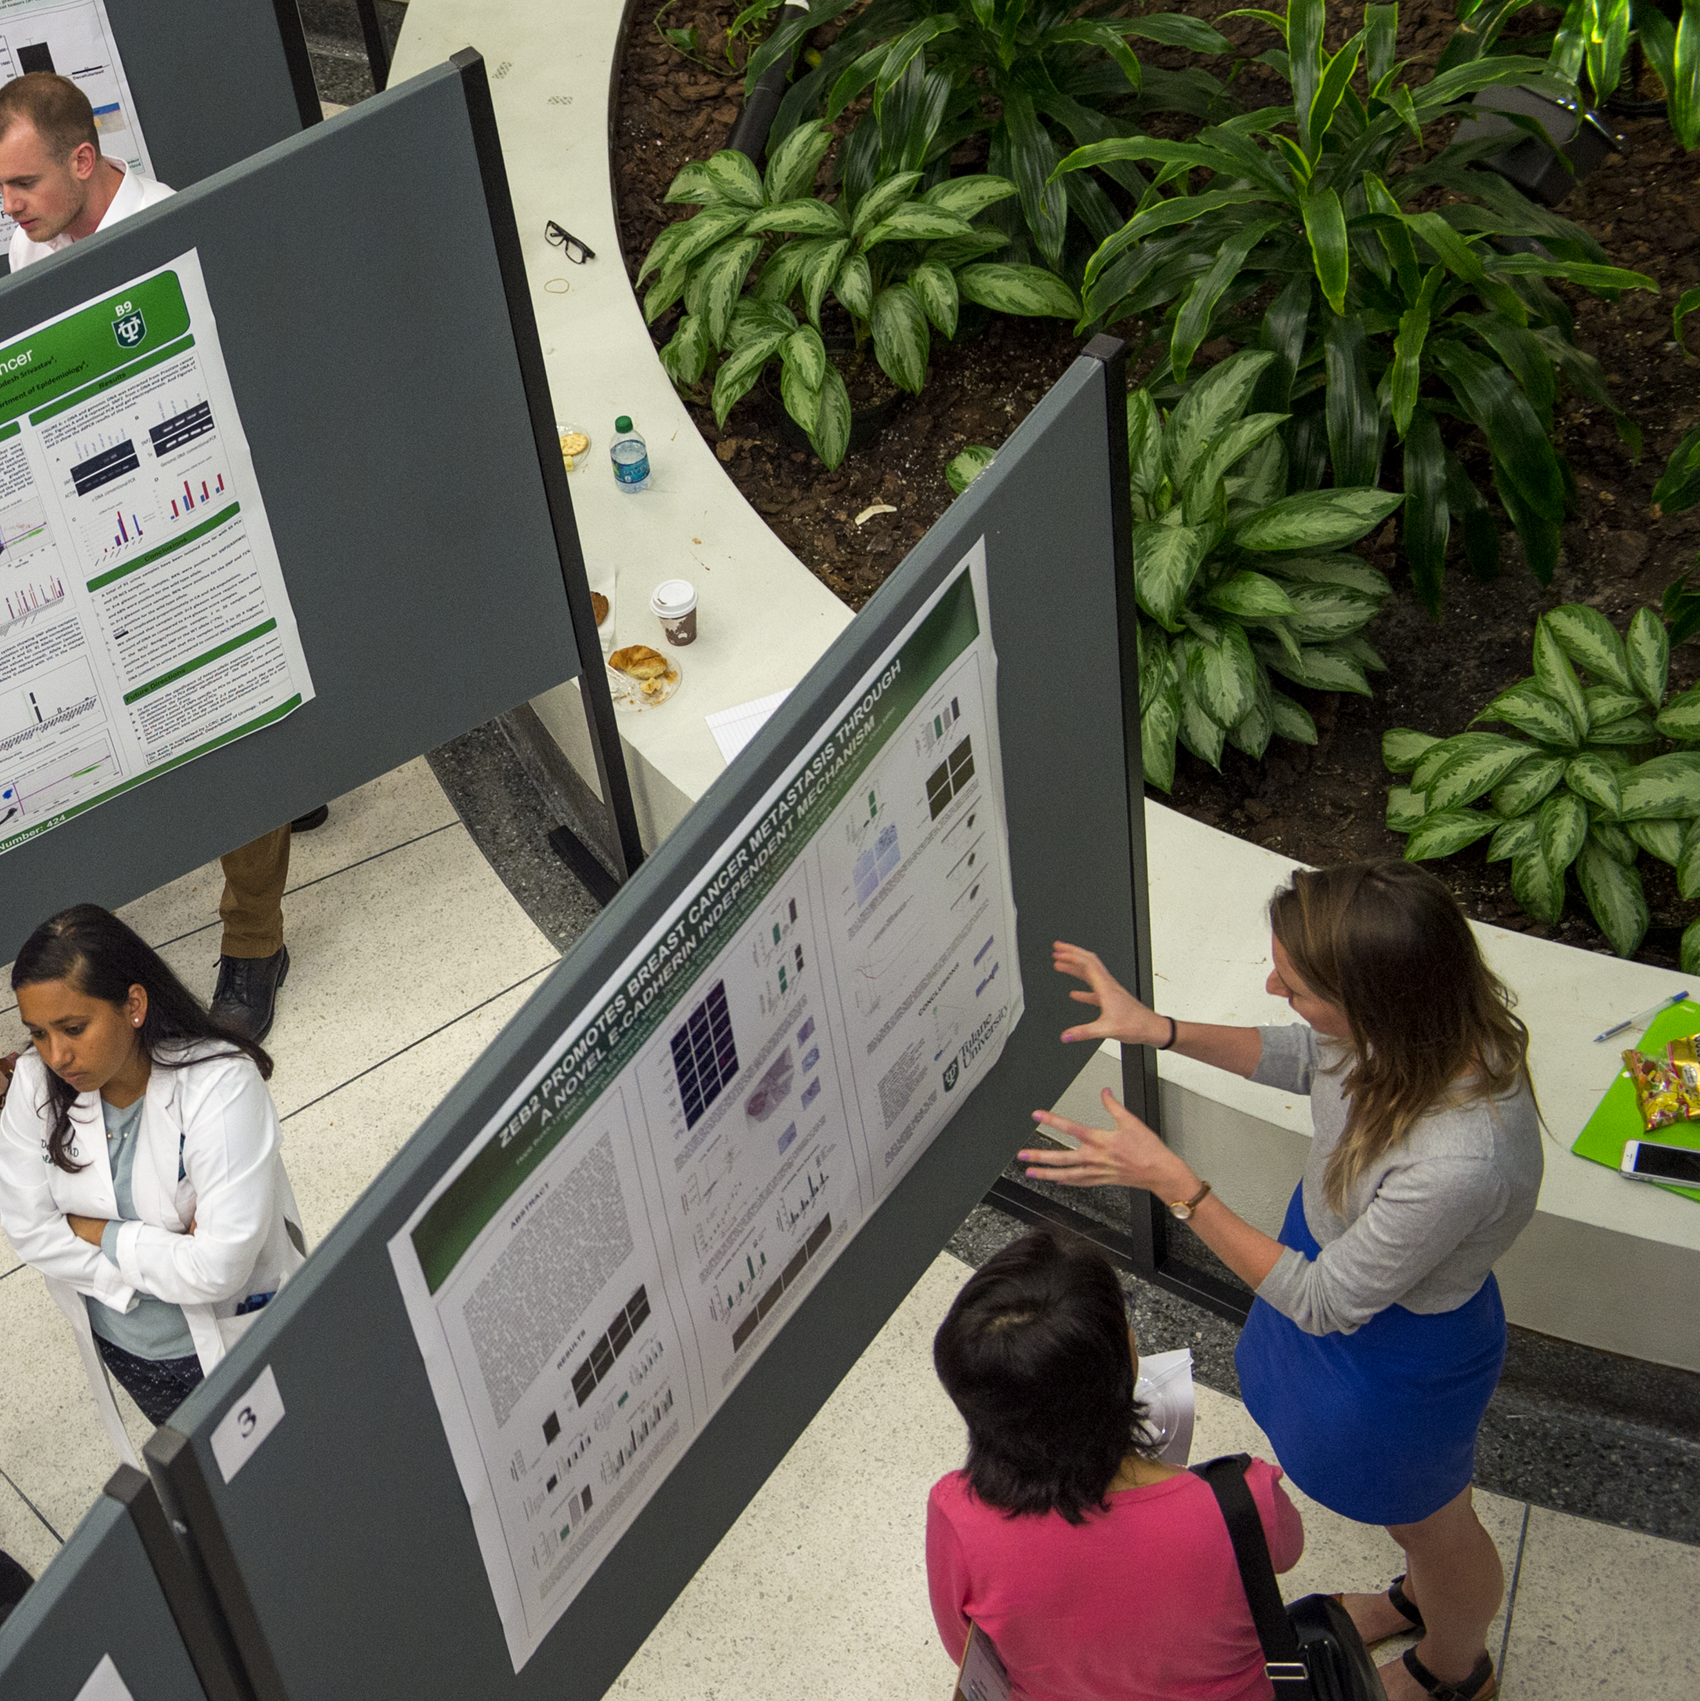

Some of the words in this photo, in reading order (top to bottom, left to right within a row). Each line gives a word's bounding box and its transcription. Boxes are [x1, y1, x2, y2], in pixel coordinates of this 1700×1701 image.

[114, 300, 133, 317] B9
[98, 372, 127, 390] Results
[143, 536, 188, 563] Conclusions
[125, 687, 150, 703] Future
[149, 668, 186, 690] Directions
[46, 815, 68, 830] 424
[499, 1094, 541, 1148] ZEB2
[541, 993, 627, 1099] PROMOTES
[626, 919, 686, 998] BREAST
[688, 848, 749, 925] CANCER
[748, 742, 836, 852] METASTASIS
[835, 659, 901, 744] THROUGH
[540, 1107, 553, 1127] A
[553, 1047, 607, 1109] NOVEL
[607, 934, 697, 1047] E-CADHERIN
[698, 814, 794, 939] INDEPENDENT
[796, 715, 875, 819] MECHANISM
[917, 961, 960, 1017] CONCLUSIONS
[958, 1012, 993, 1058] Tulane
[962, 1005, 1008, 1070] University
[510, 1182, 550, 1230] ABSTRACT
[556, 1328, 587, 1370] RESULTS
[237, 1406, 257, 1439] 3
